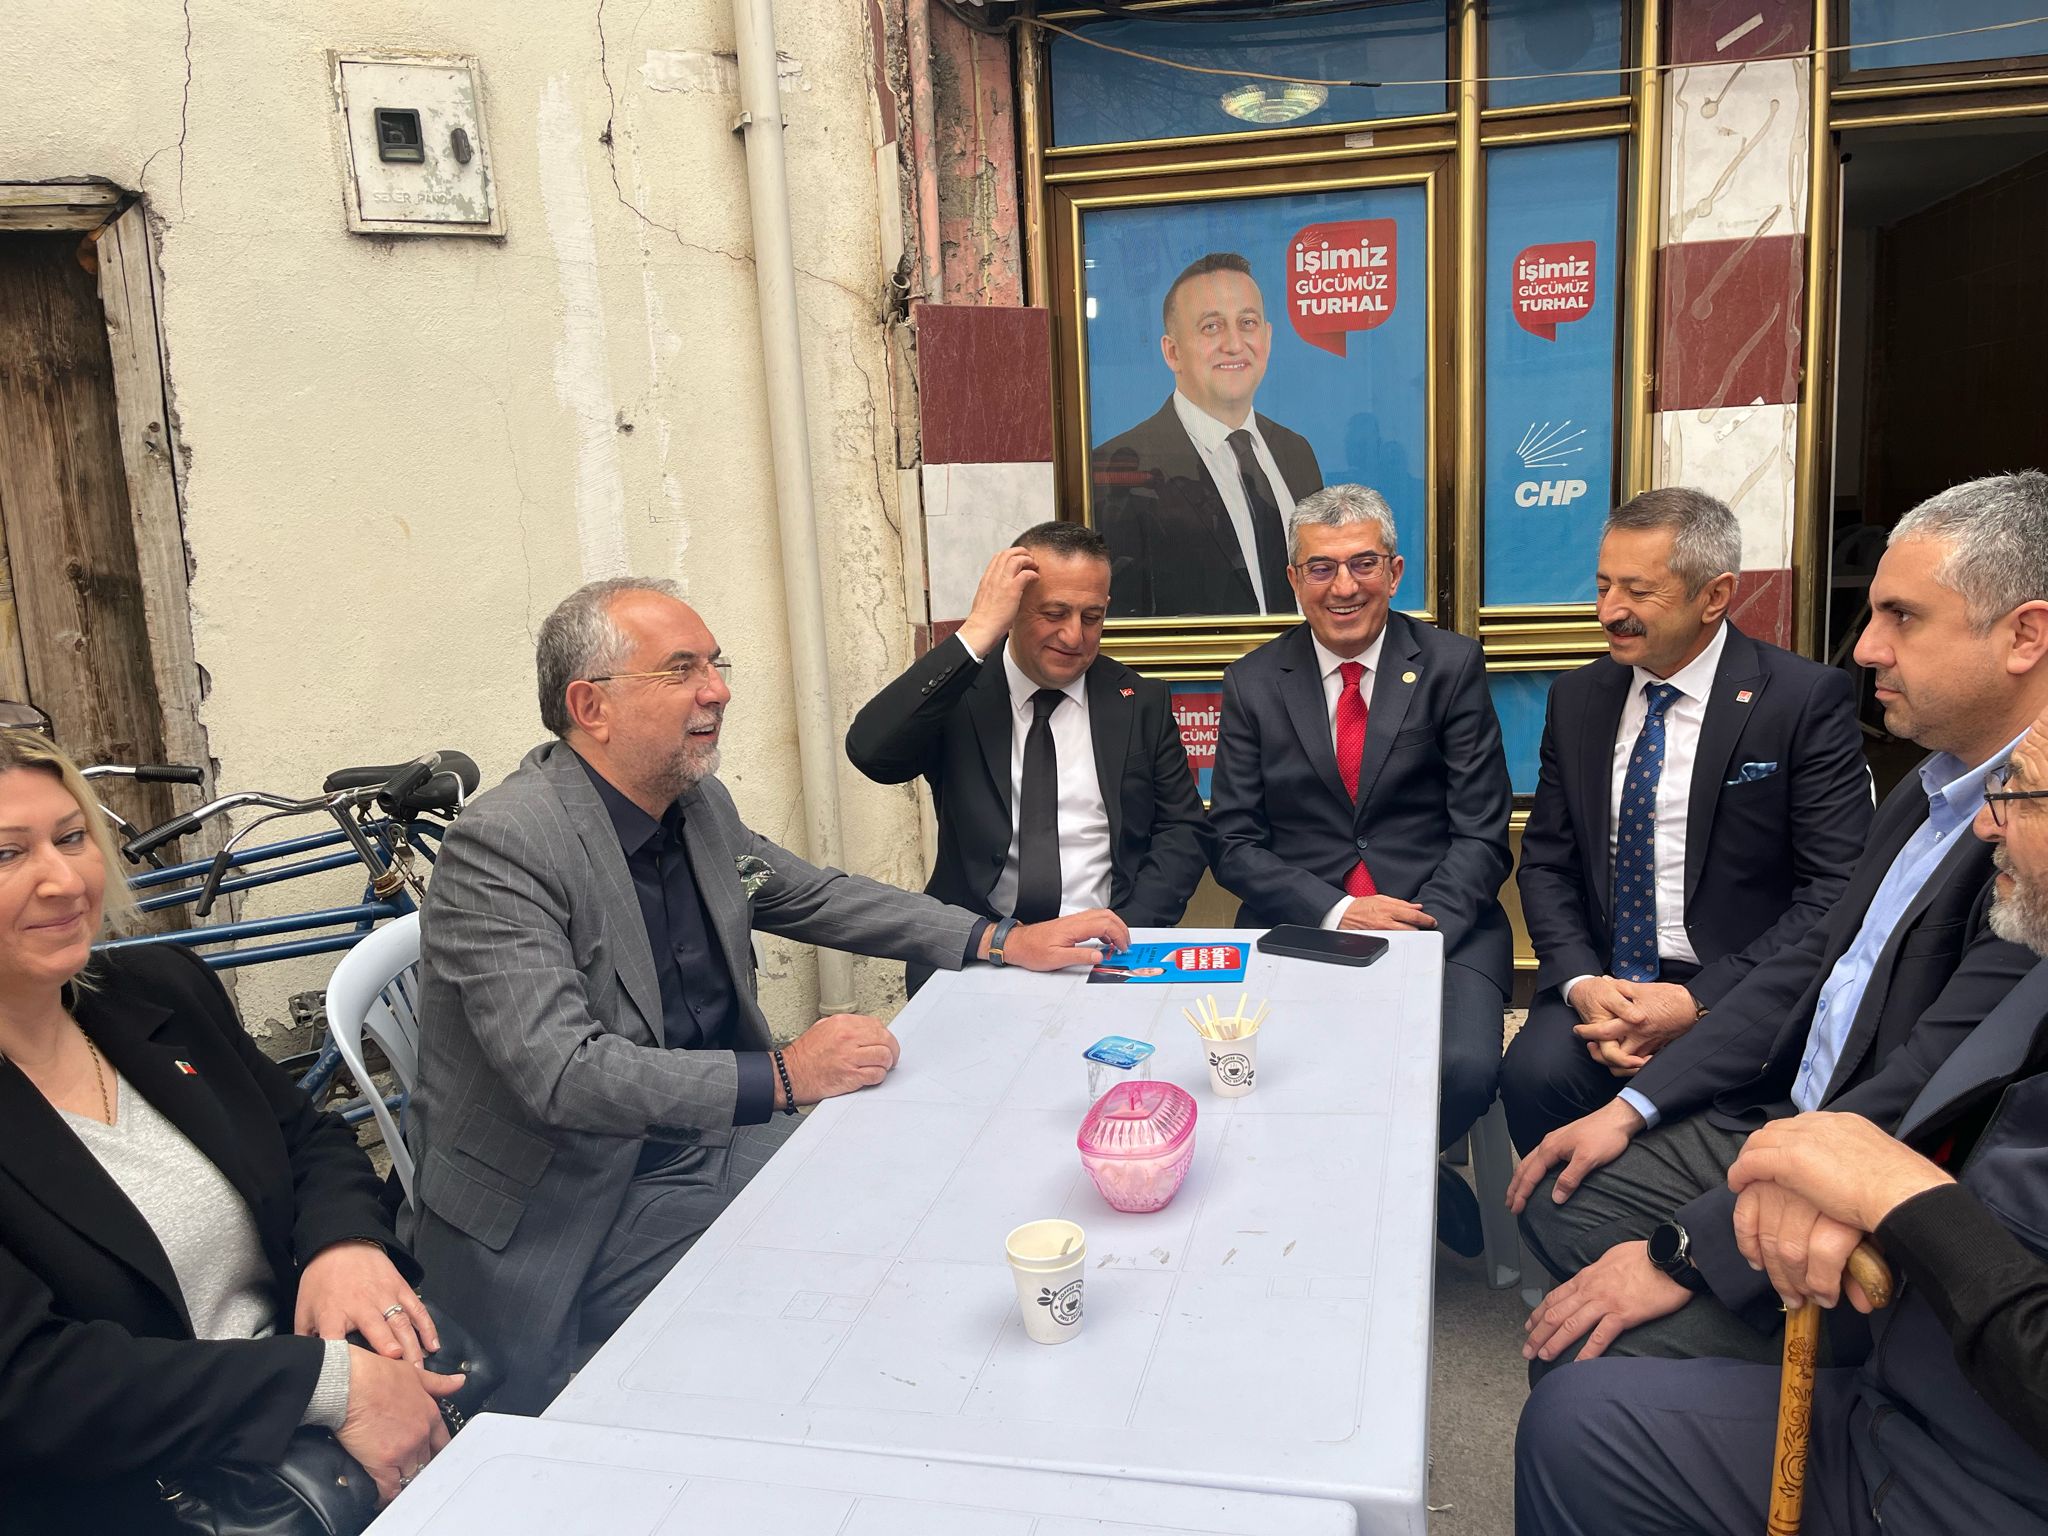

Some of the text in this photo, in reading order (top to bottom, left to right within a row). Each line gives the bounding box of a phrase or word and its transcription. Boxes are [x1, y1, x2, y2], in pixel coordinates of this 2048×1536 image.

[1296, 238, 1388, 274] işimiz
[1519, 255, 1589, 281] işimiz
[1295, 271, 1388, 295] GÜCÜMÜZ
[1518, 279, 1589, 297] GÜCÜMÜZ
[1296, 294, 1389, 316] TURHAL
[1519, 296, 1589, 312] TURHAL
[1514, 479, 1588, 508] CHP
[1180, 728, 1219, 741] CÜMÜ
[1185, 745, 1217, 756] RHA
[1057, 1284, 1075, 1301] COFFEE
